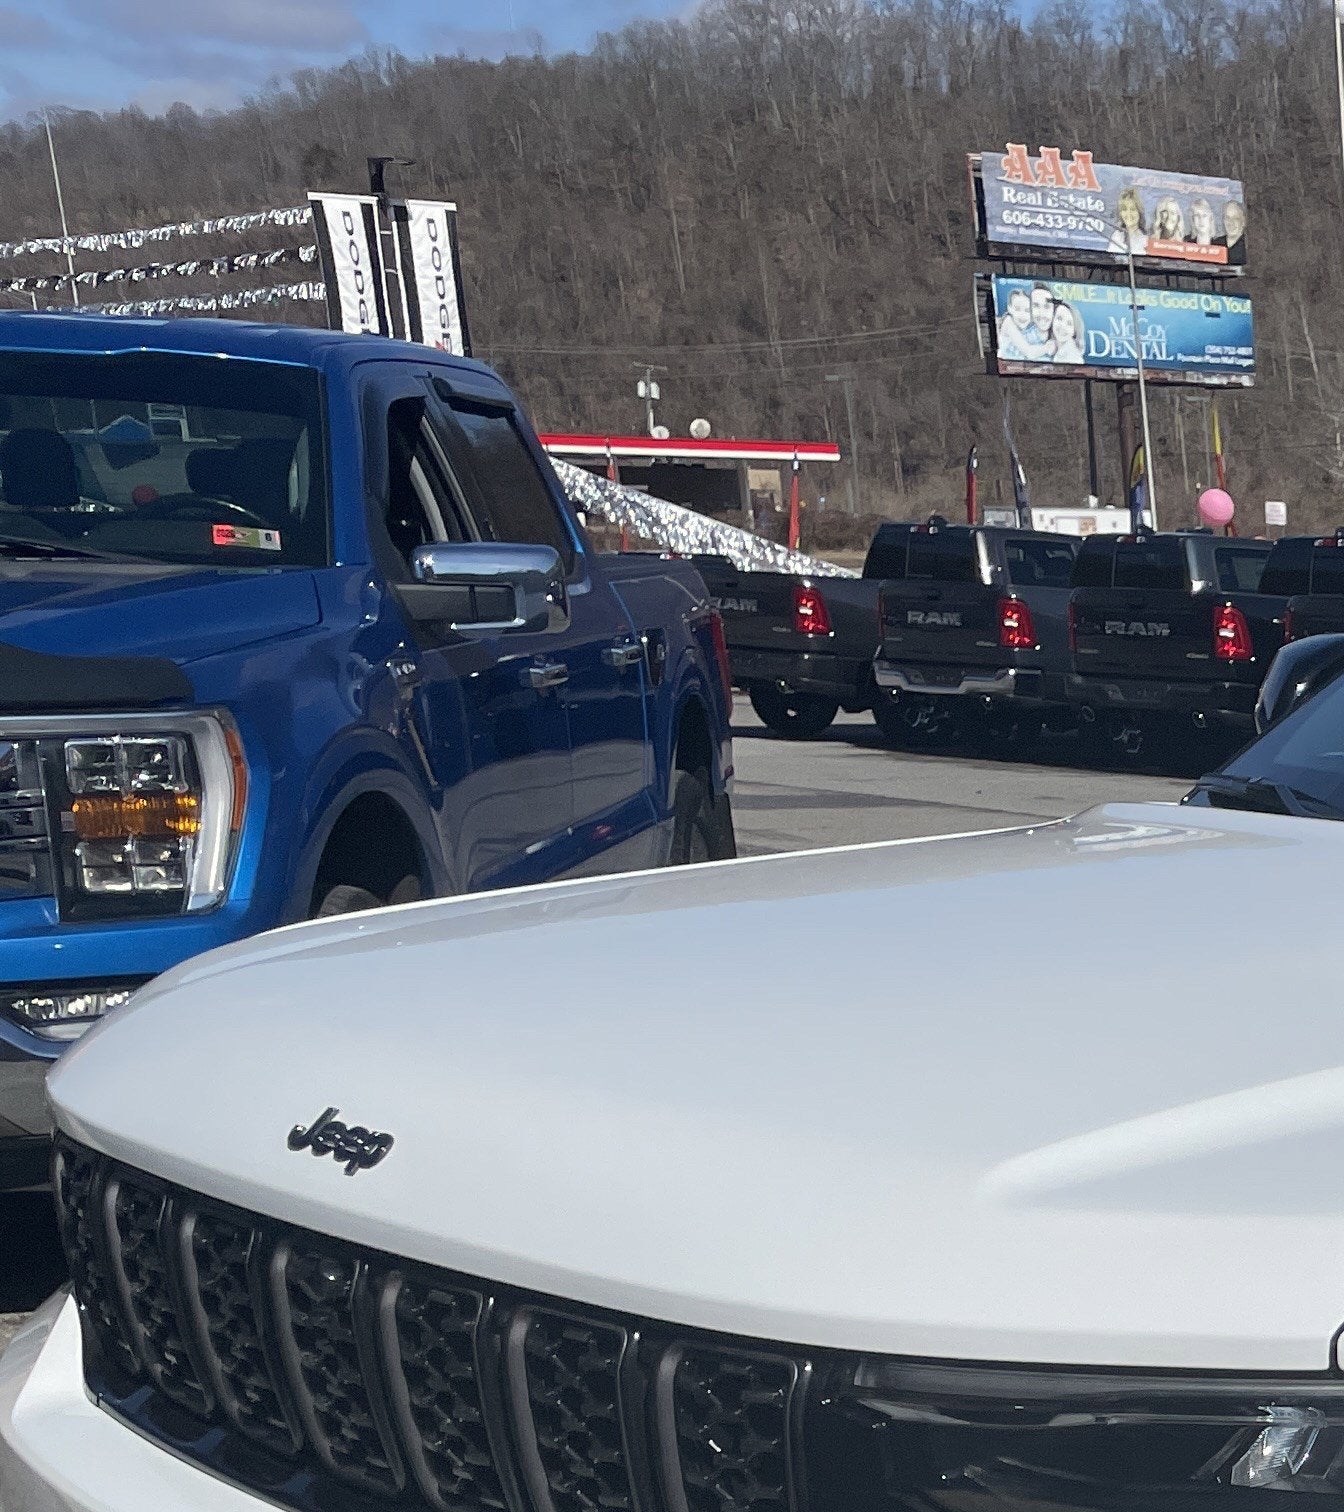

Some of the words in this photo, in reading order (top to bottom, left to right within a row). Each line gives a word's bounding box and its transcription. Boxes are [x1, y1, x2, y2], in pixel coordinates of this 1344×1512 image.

[999, 142, 1102, 192] AAA
[1002, 186, 1042, 205] Real
[1047, 191, 1105, 213] Estate
[1160, 291, 1199, 310] Good
[1087, 329, 1174, 361] DENTAL
[907, 610, 962, 626] RAM
[1105, 620, 1171, 636] RAM
[287, 1107, 394, 1176] Jeep
